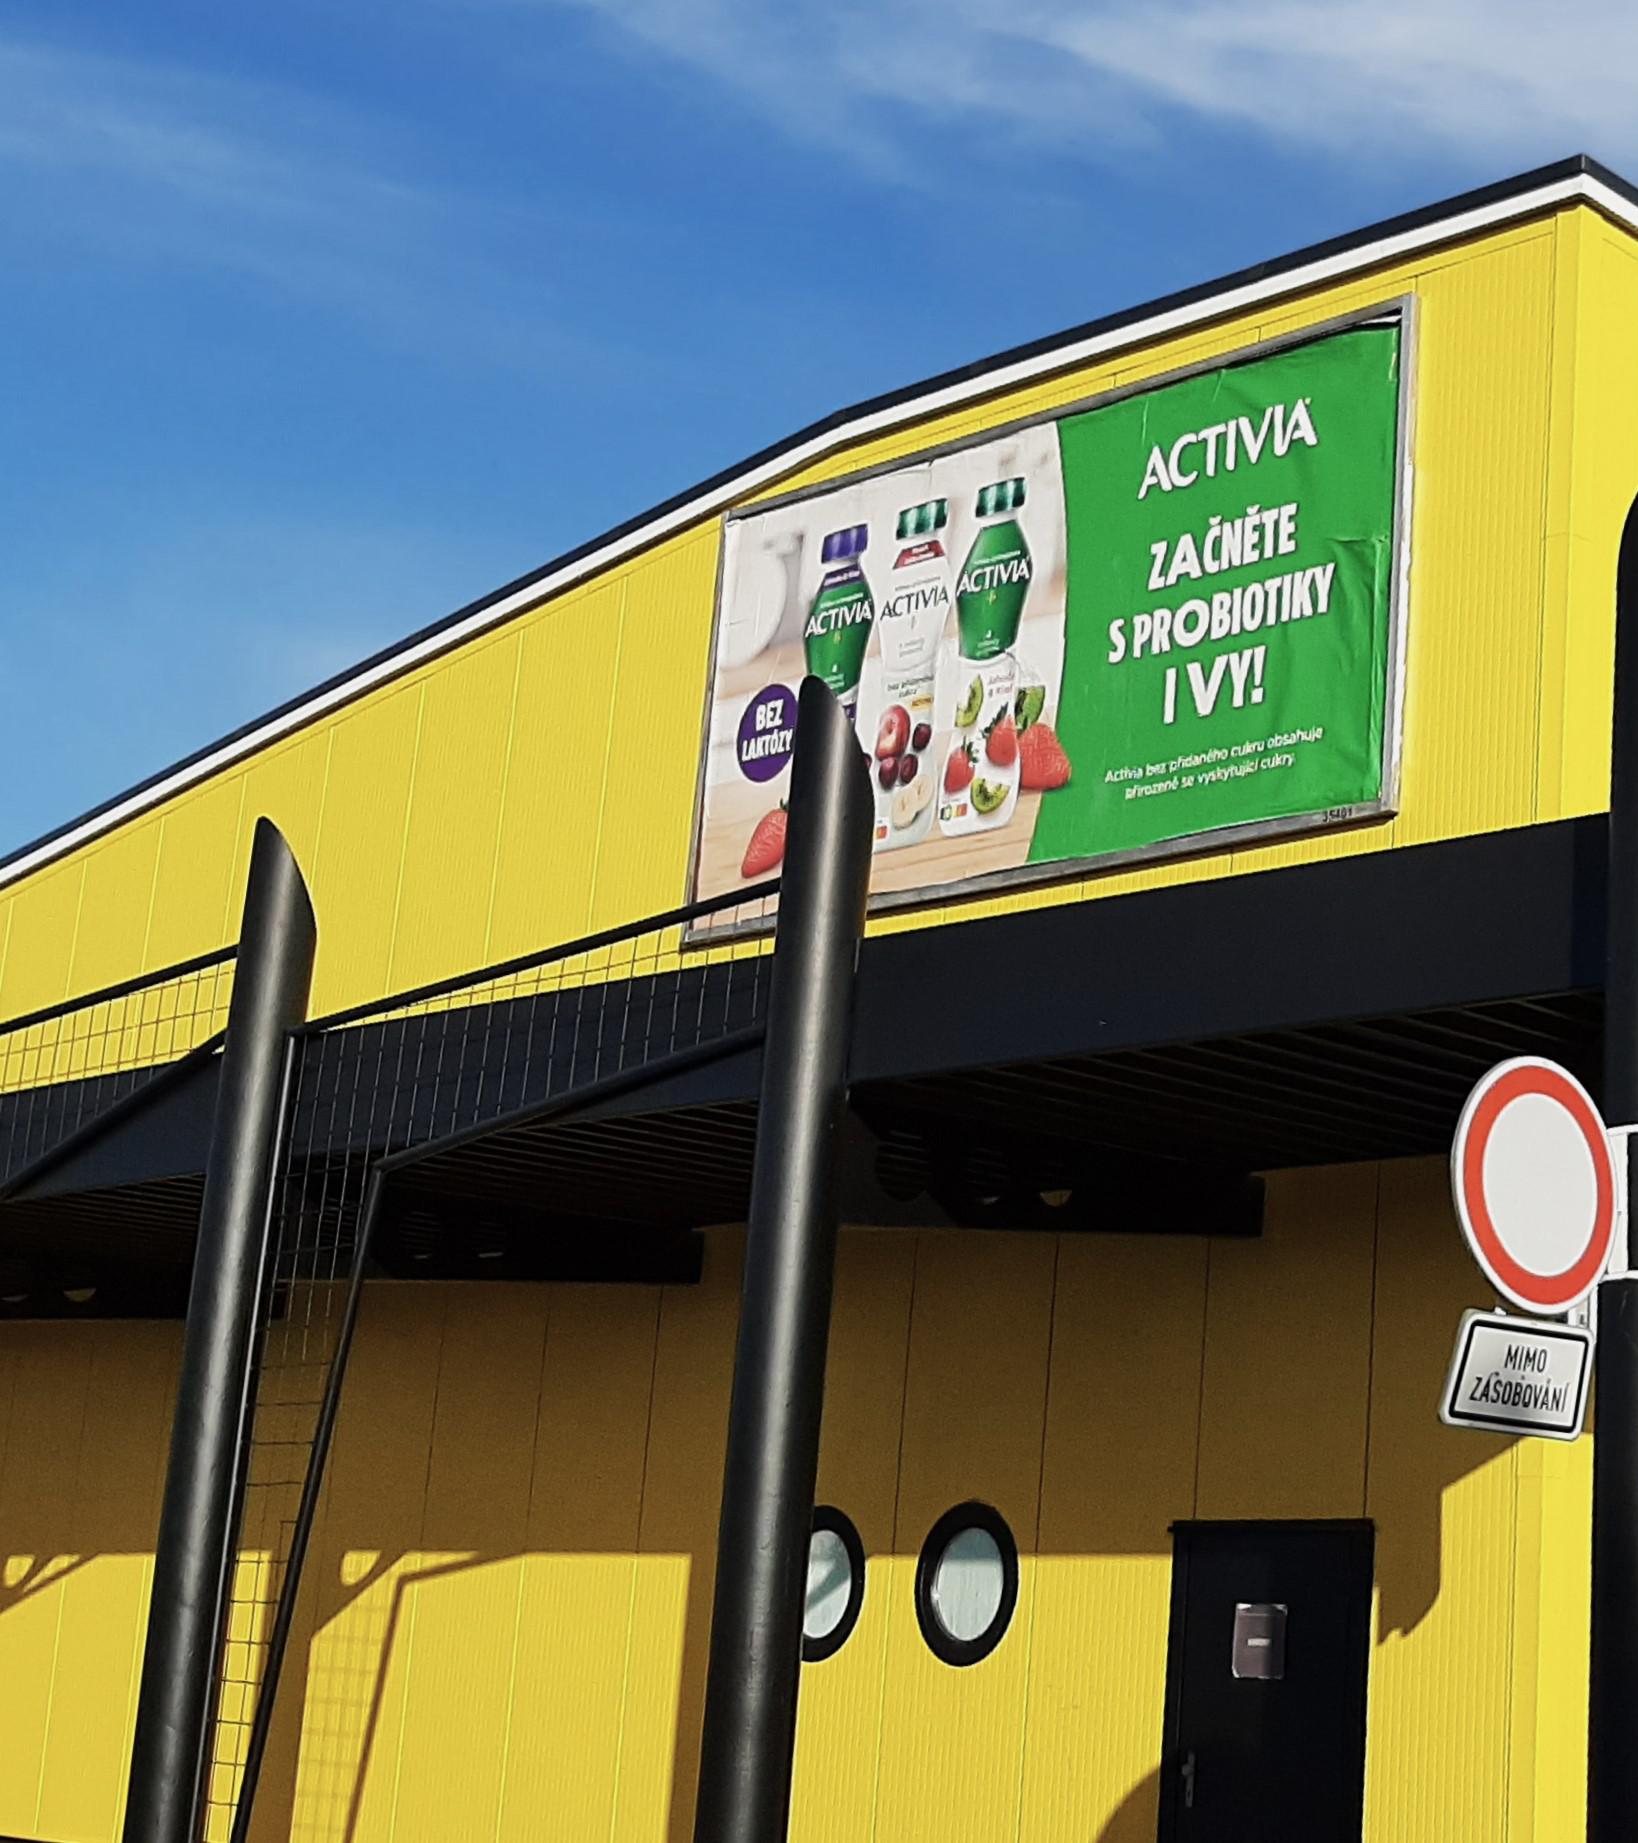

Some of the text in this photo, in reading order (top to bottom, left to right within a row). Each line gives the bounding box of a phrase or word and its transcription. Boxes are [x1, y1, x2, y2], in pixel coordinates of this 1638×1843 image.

[1137, 398, 1318, 500] ACTIVIA
[1148, 502, 1298, 591] ZAČNĚTE
[956, 555, 1032, 596] ACTIVIA
[805, 600, 873, 638] ACTIVIA
[880, 585, 949, 620] ACTIVIA
[1108, 562, 1336, 664] S PROBIOTIKY
[1163, 645, 1266, 724] I VY!
[756, 699, 784, 731] BEZ
[741, 728, 794, 763] LAKTÓZY
[1104, 768, 1143, 783] Activia
[1146, 763, 1168, 777] bez
[1231, 741, 1265, 757] cukru
[1266, 726, 1324, 751] obsahuje
[1181, 774, 1195, 788] se
[1198, 760, 1260, 786] vyskytující
[1504, 1344, 1547, 1373] MIMO
[1469, 1373, 1571, 1413] ZÁSOBOVÁNÍ
